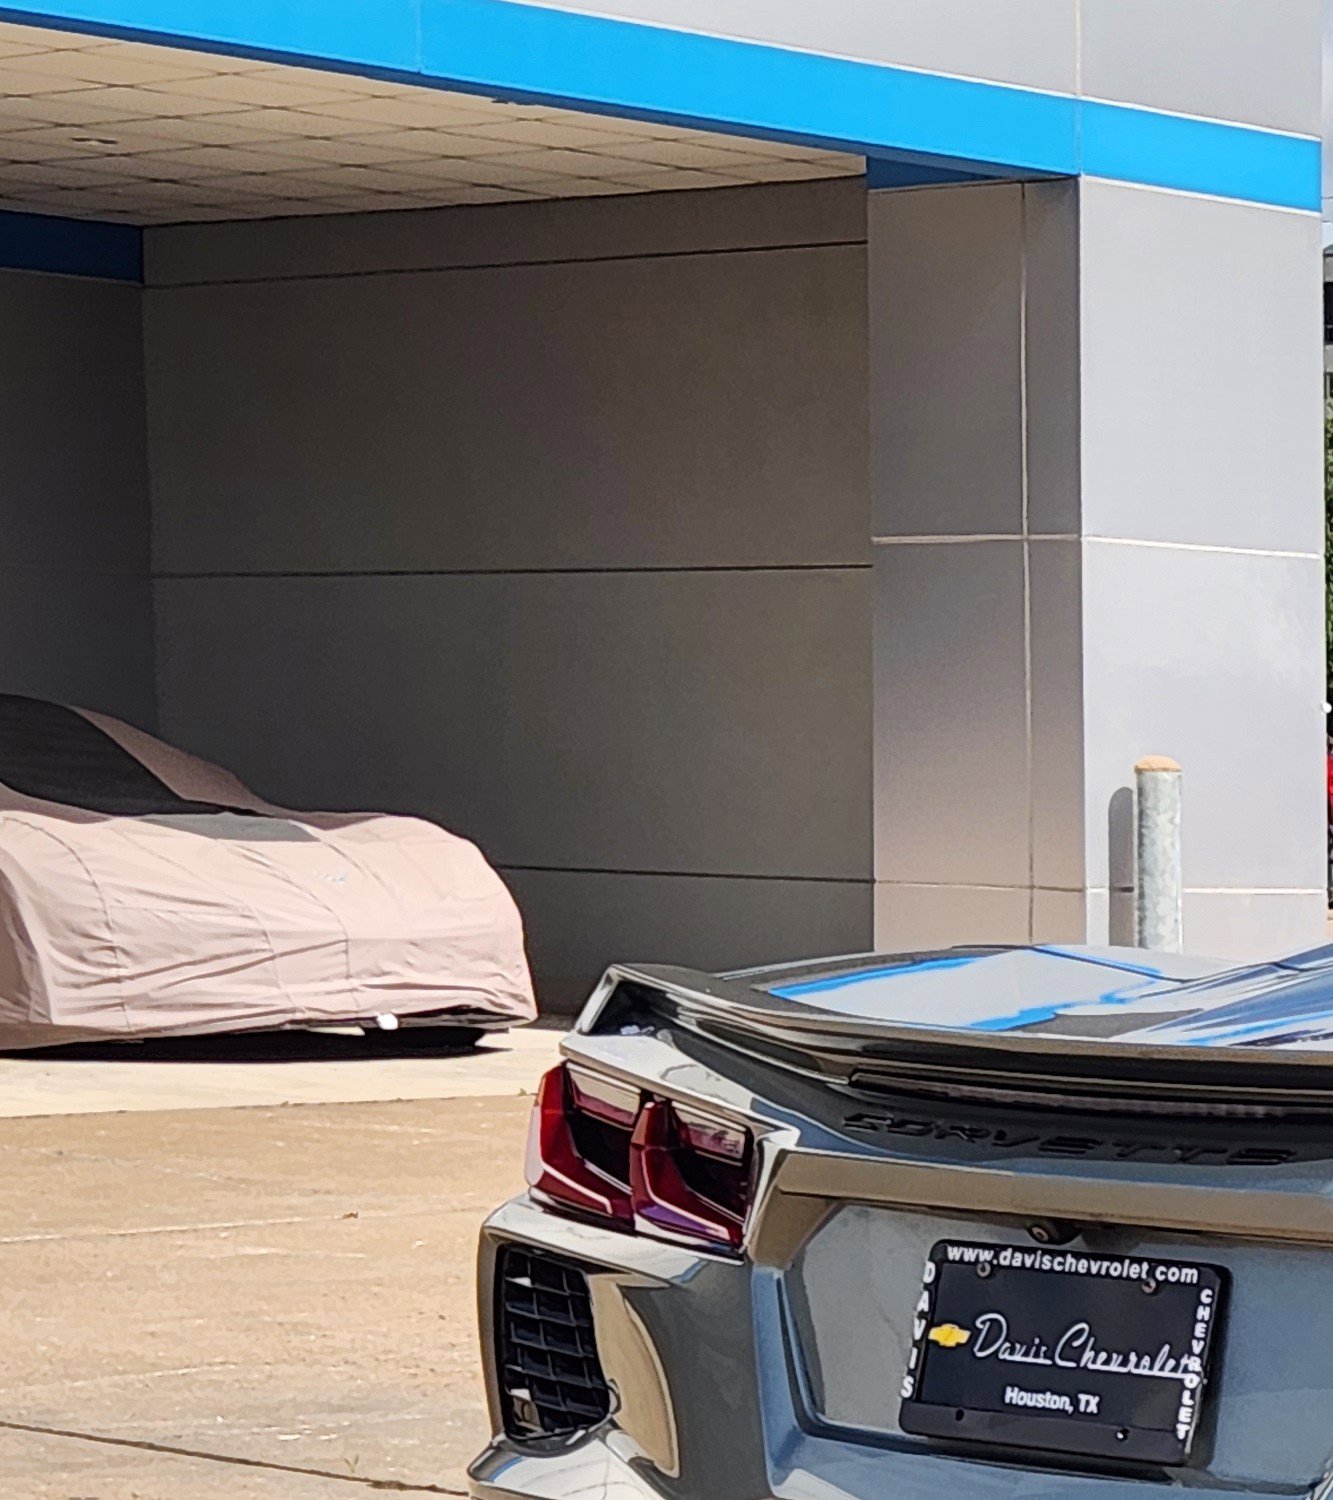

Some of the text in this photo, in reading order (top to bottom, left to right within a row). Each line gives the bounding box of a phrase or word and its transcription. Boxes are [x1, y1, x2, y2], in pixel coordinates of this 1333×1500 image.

[842, 1113, 1297, 1166] CORVETTE
[901, 1260, 936, 1399] DAVIS
[972, 1313, 1053, 1366] Davis
[1176, 1288, 1214, 1440] CHEVROLET
[1004, 1386, 1100, 1415] Houston, TX
